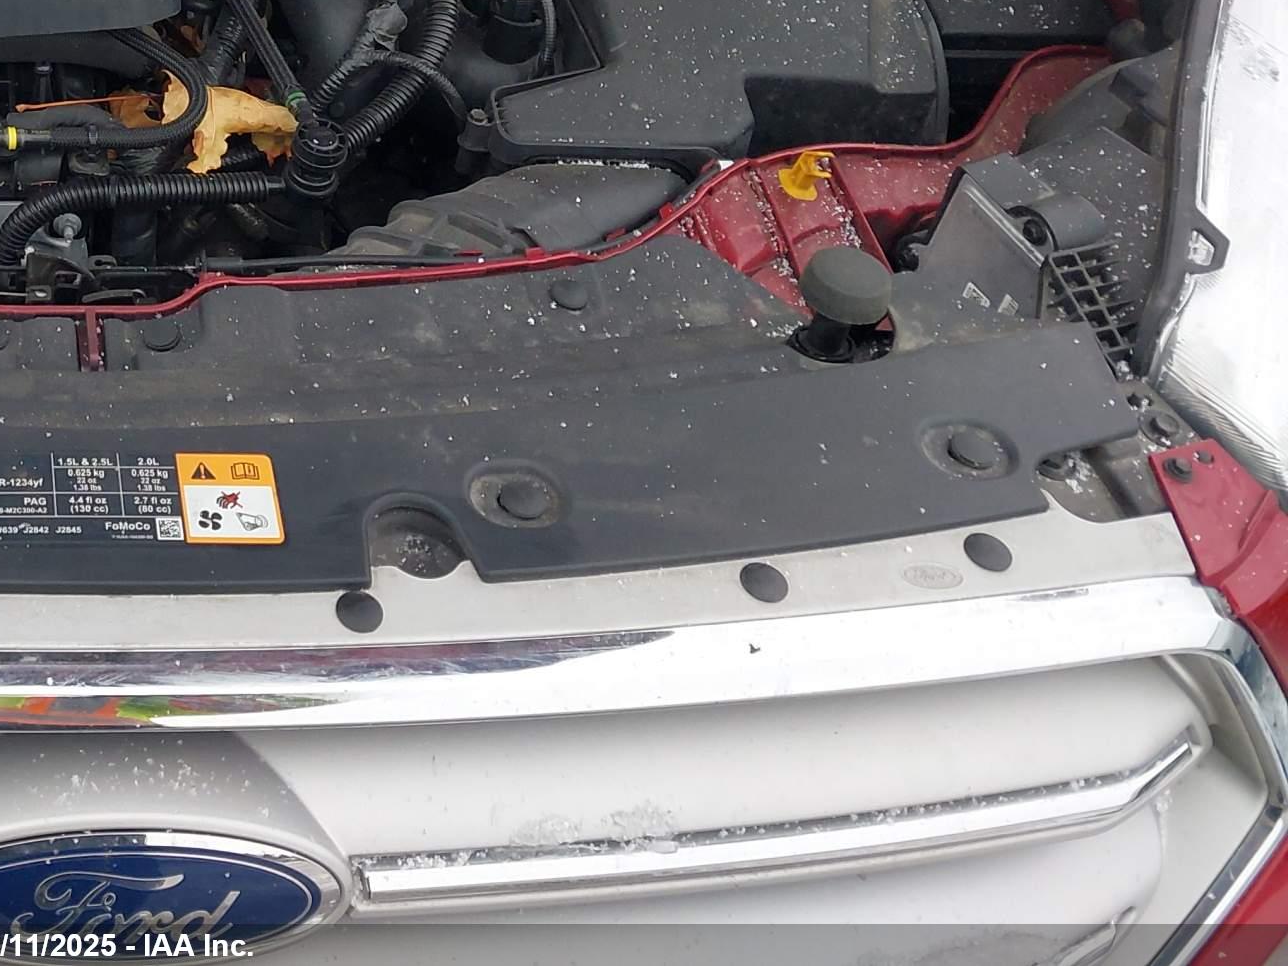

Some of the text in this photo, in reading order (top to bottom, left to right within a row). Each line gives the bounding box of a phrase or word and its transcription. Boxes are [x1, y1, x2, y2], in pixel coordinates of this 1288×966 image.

[57, 458, 113, 466] 1.5L & 2.5L
[137, 458, 159, 466] 2.0L
[67, 469, 105, 478] 0.625 kg
[131, 469, 168, 479] 0.625 kg
[24, 497, 47, 506] PAG
[86, 496, 92, 504] fl
[151, 496, 158, 504] fl
[70, 505, 109, 513] (130 cc)
[156, 505, 172, 514] cc)
[23, 526, 49, 534] J2842
[104, 521, 151, 531] FoMoCo
[10, 871, 240, 943] Ford
